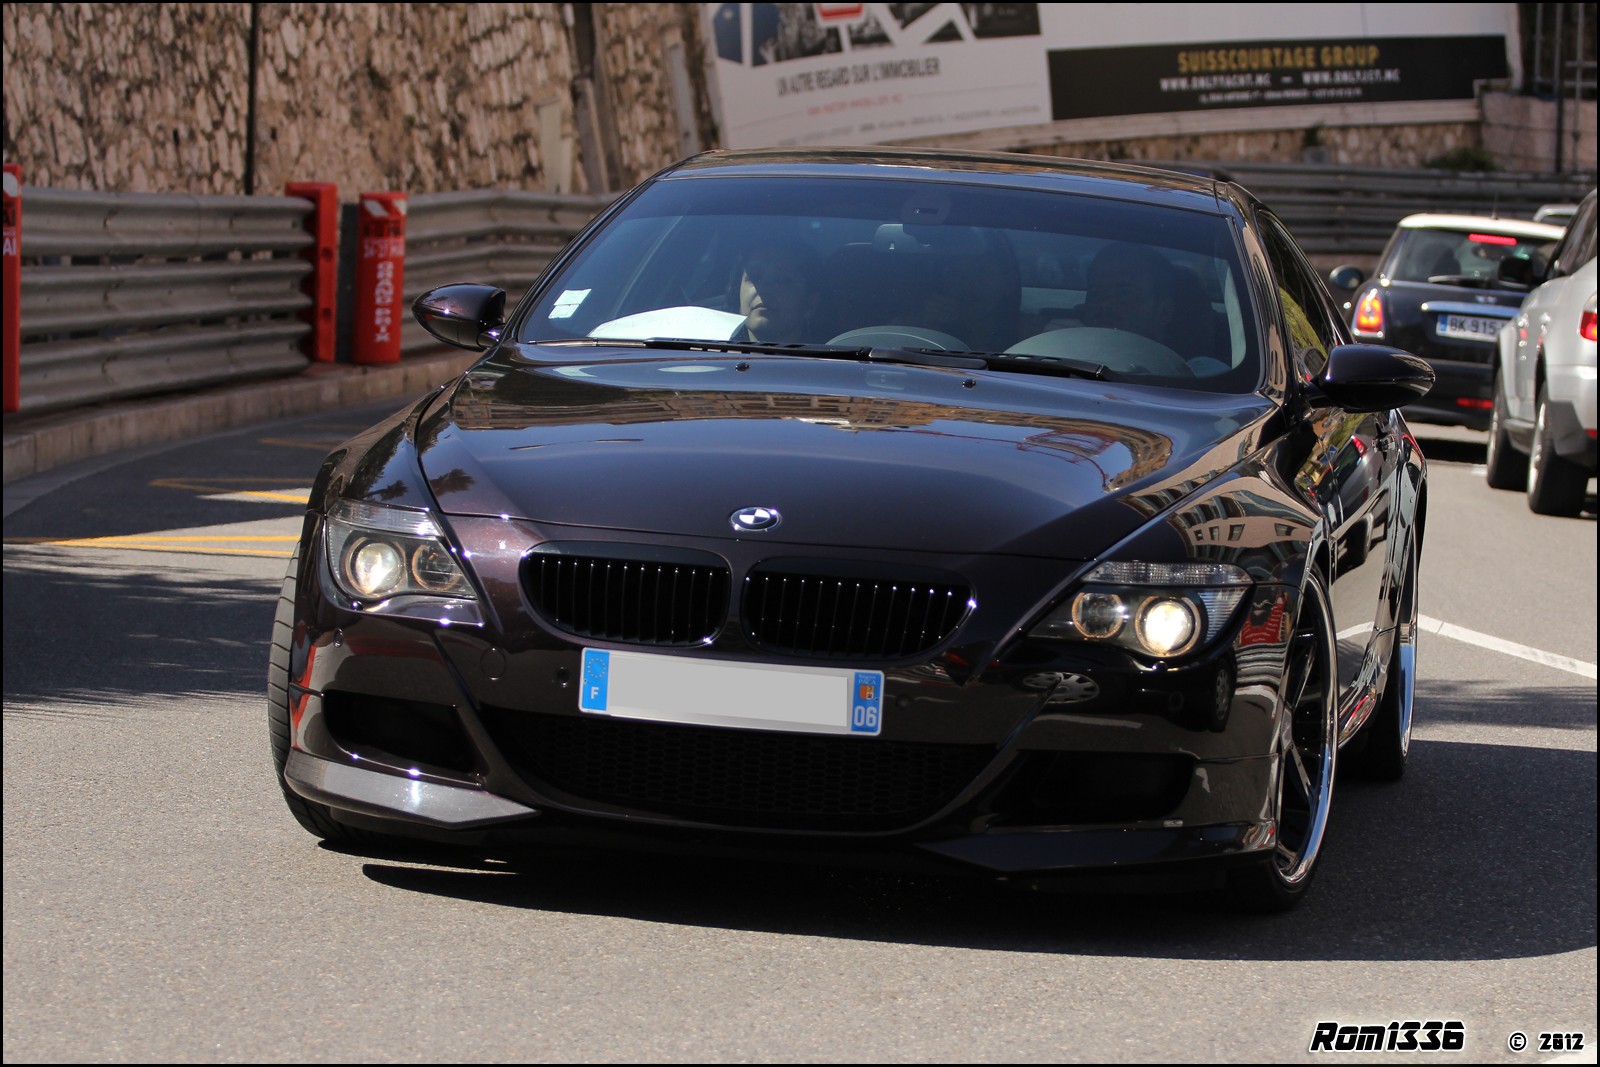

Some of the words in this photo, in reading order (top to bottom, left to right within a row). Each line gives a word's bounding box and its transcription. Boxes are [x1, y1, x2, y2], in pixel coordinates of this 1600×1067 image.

[1177, 48, 1316, 73] SUISSCOURTAGE
[1321, 45, 1379, 67] GROUP
[852, 64, 870, 84] SUR
[590, 686, 600, 700] F
[853, 705, 877, 727] 06
